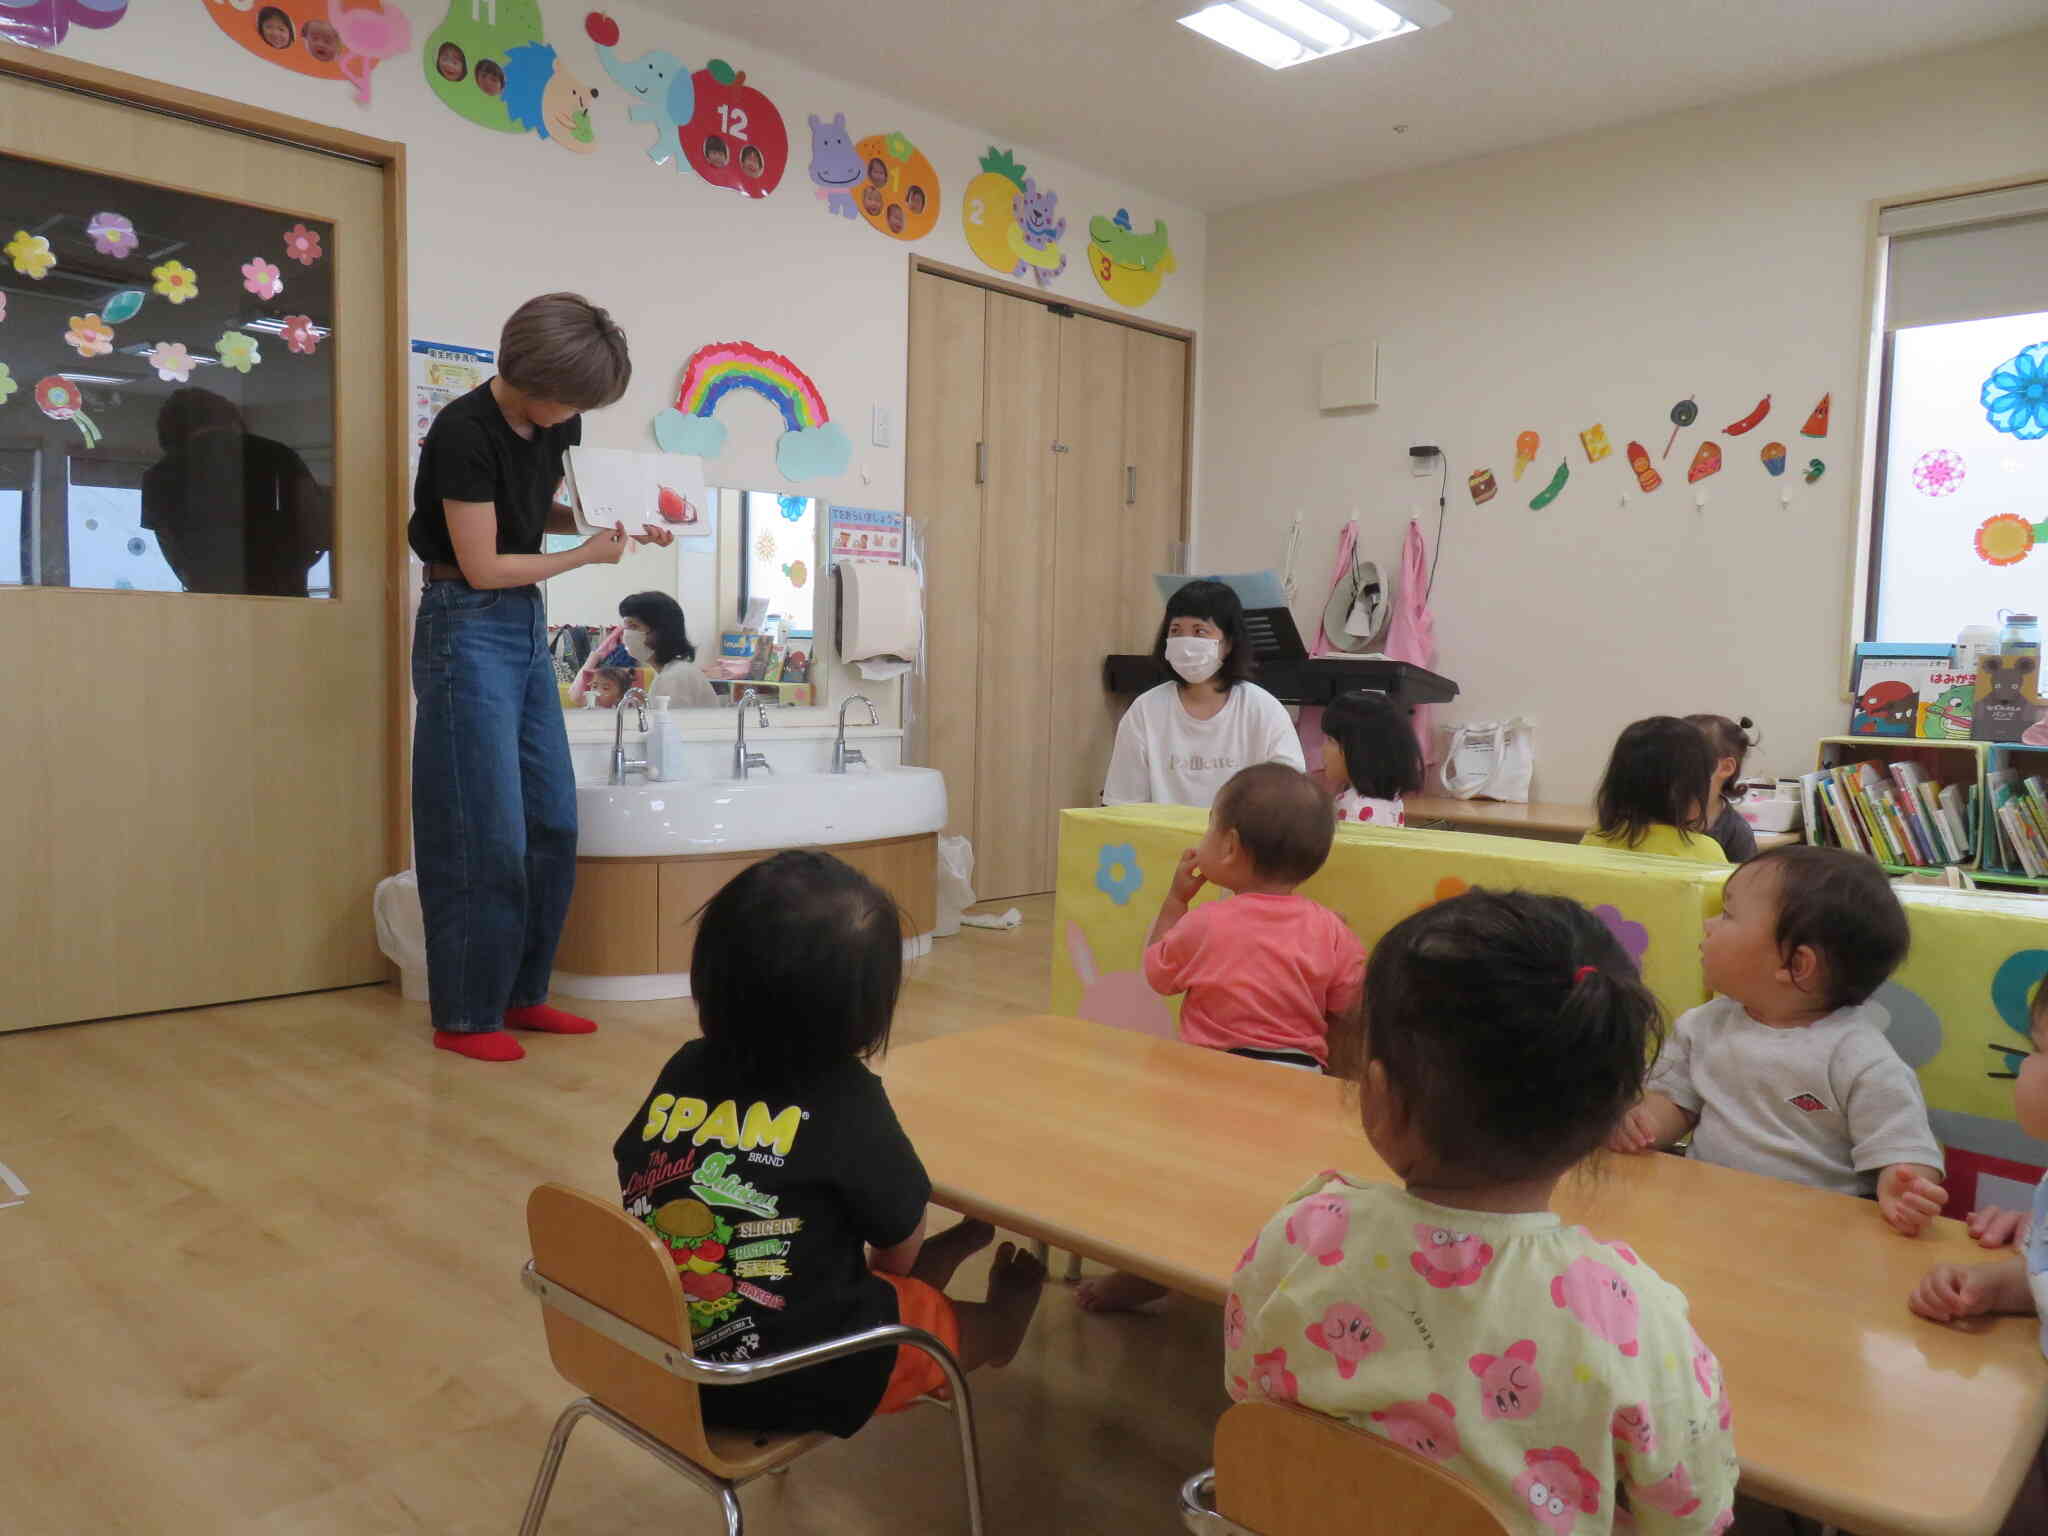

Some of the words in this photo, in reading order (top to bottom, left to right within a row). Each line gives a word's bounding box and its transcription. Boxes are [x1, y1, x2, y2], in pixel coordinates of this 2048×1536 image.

[717, 103, 749, 141] 12
[890, 166, 899, 192] 1
[970, 198, 986, 225] 2
[1100, 256, 1112, 281] 3
[642, 1093, 802, 1157] SPAM
[624, 1148, 697, 1197] Original
[748, 1152, 785, 1168] BRAND
[1407, 1310, 1436, 1350] KIRBY
